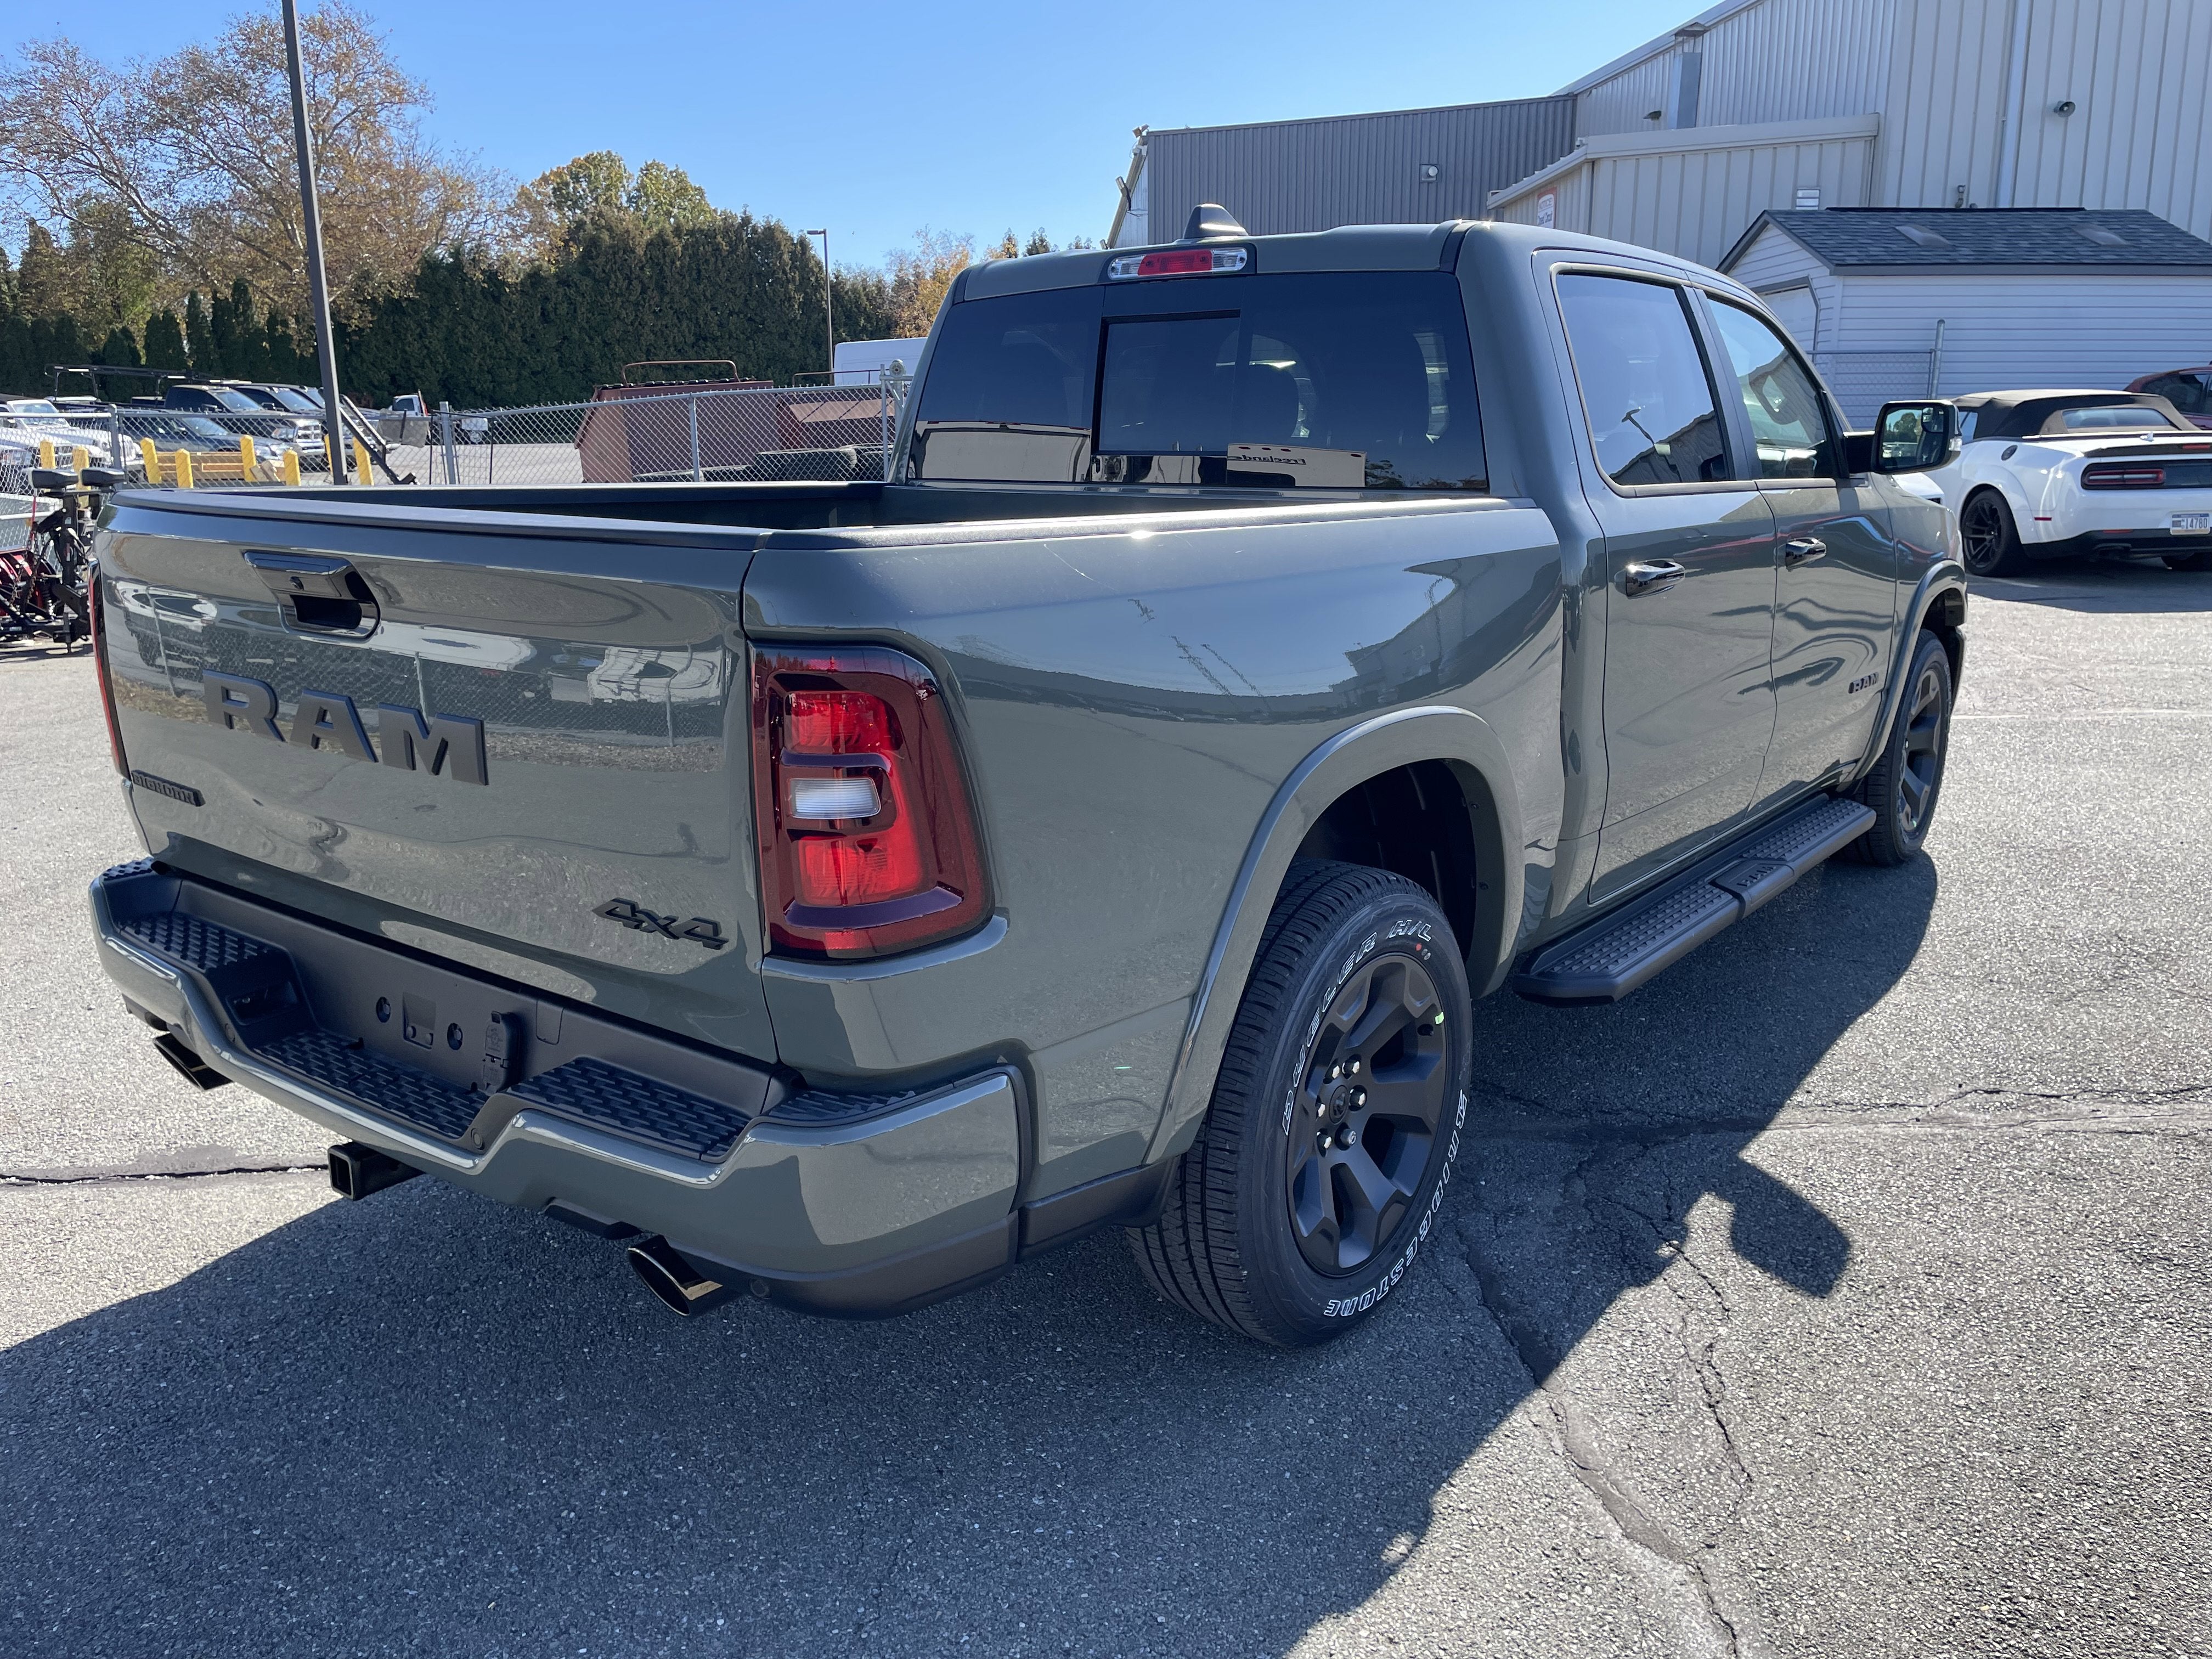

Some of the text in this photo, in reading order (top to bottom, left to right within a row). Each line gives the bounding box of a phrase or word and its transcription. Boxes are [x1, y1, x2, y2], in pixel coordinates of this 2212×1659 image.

[2186, 518, 2208, 529] 14780
[204, 669, 489, 786] RAM
[1848, 672, 1879, 694] RAM
[1282, 919, 1432, 1136] DUELER H/L
[1323, 1088, 1468, 1317] BRIDGESTONE
